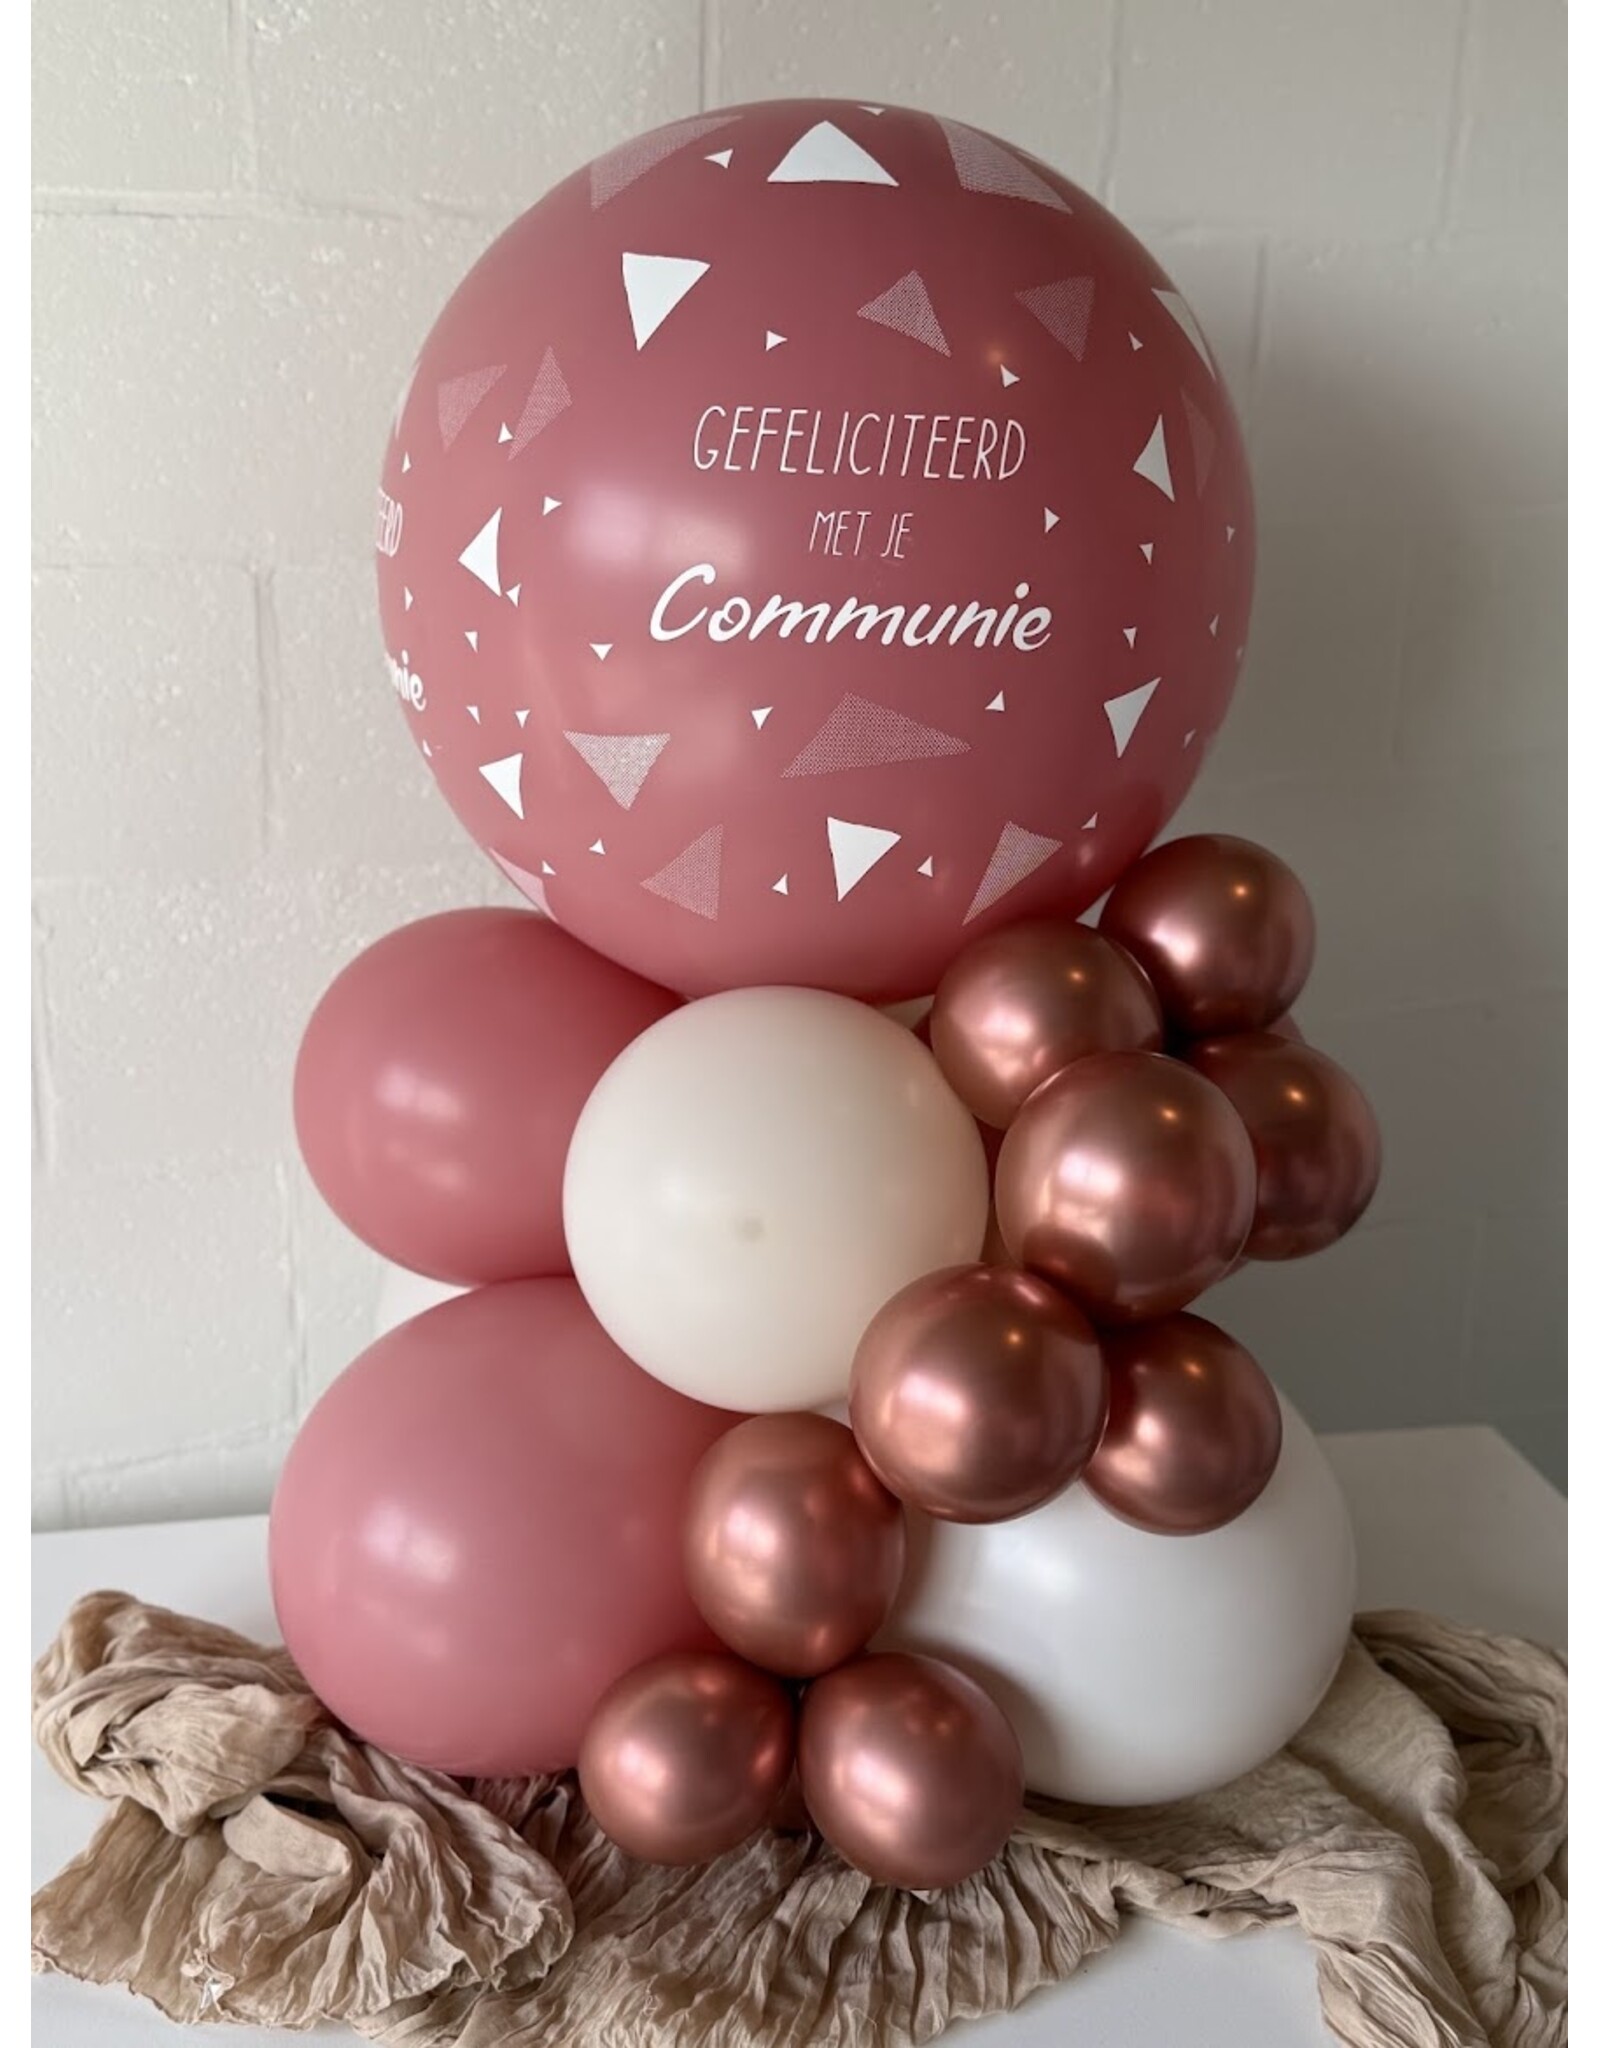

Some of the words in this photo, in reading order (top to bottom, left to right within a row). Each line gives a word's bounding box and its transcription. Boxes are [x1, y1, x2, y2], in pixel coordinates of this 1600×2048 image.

[692, 405, 1027, 481] GEFELICITEERD
[808, 510, 872, 556] MET
[880, 512, 914, 559] JE
[649, 563, 1052, 652] Communie
